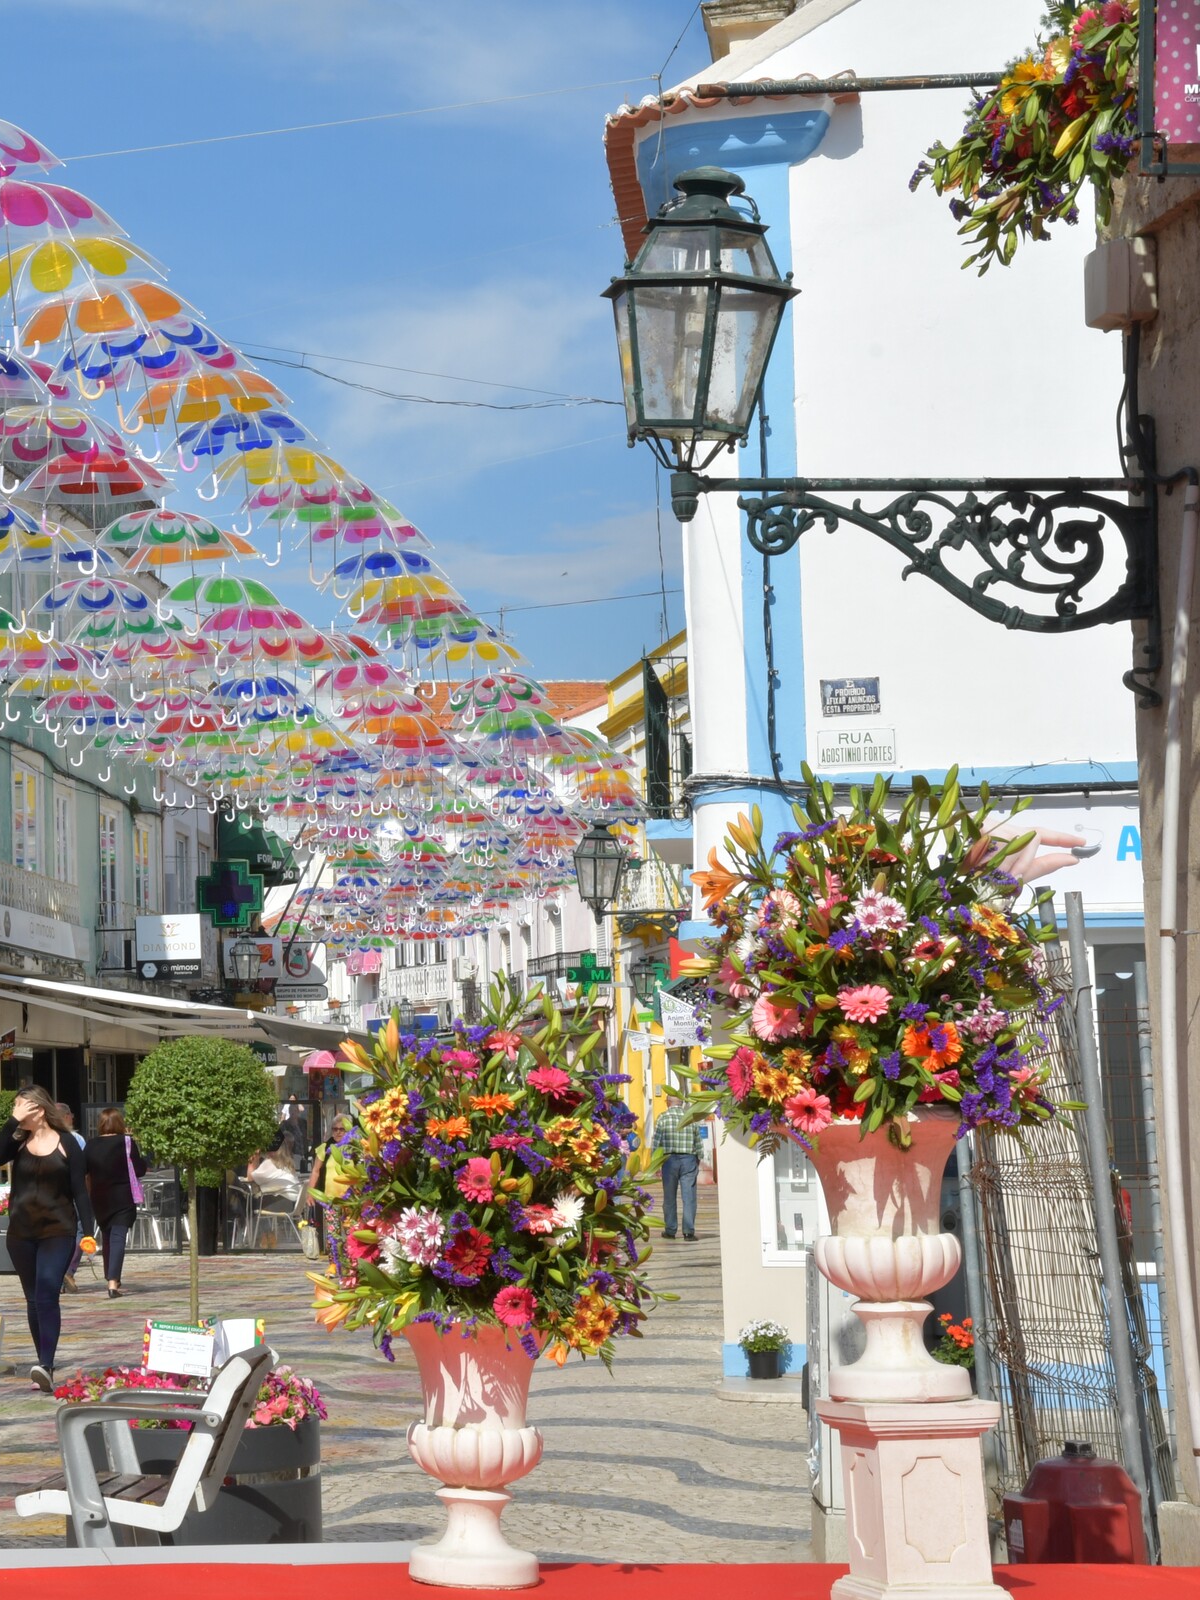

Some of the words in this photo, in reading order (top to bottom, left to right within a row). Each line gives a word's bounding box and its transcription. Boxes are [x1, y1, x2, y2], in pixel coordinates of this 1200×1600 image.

[834, 687, 866, 697] PROIBIDO
[848, 695, 876, 704] ANUNCIOS
[838, 732, 873, 745] RUA
[821, 747, 862, 763] AGOSTINHO
[864, 746, 893, 762] FORTES
[143, 942, 196, 953] DIAMOND
